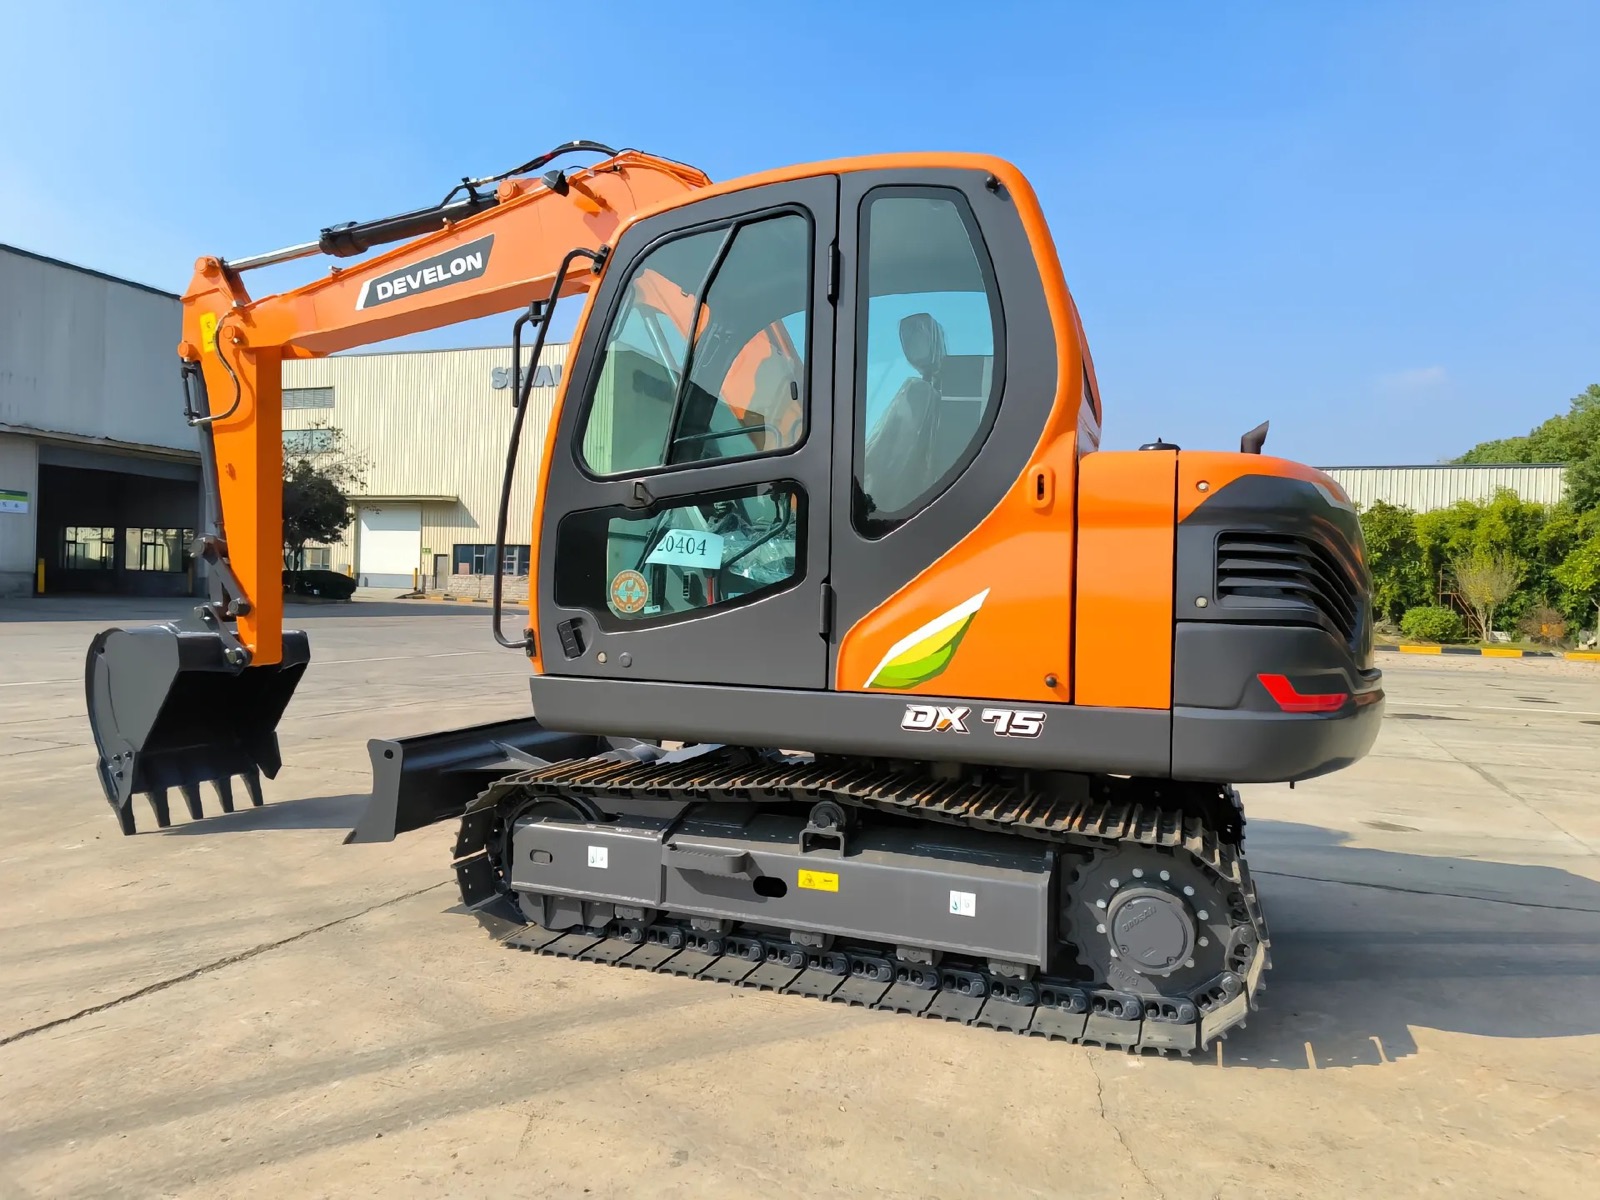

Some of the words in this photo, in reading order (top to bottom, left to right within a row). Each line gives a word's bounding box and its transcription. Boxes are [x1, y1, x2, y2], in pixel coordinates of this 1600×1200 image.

[376, 251, 483, 301] DEVELON
[901, 703, 971, 734] DX
[982, 707, 1047, 739] 75
